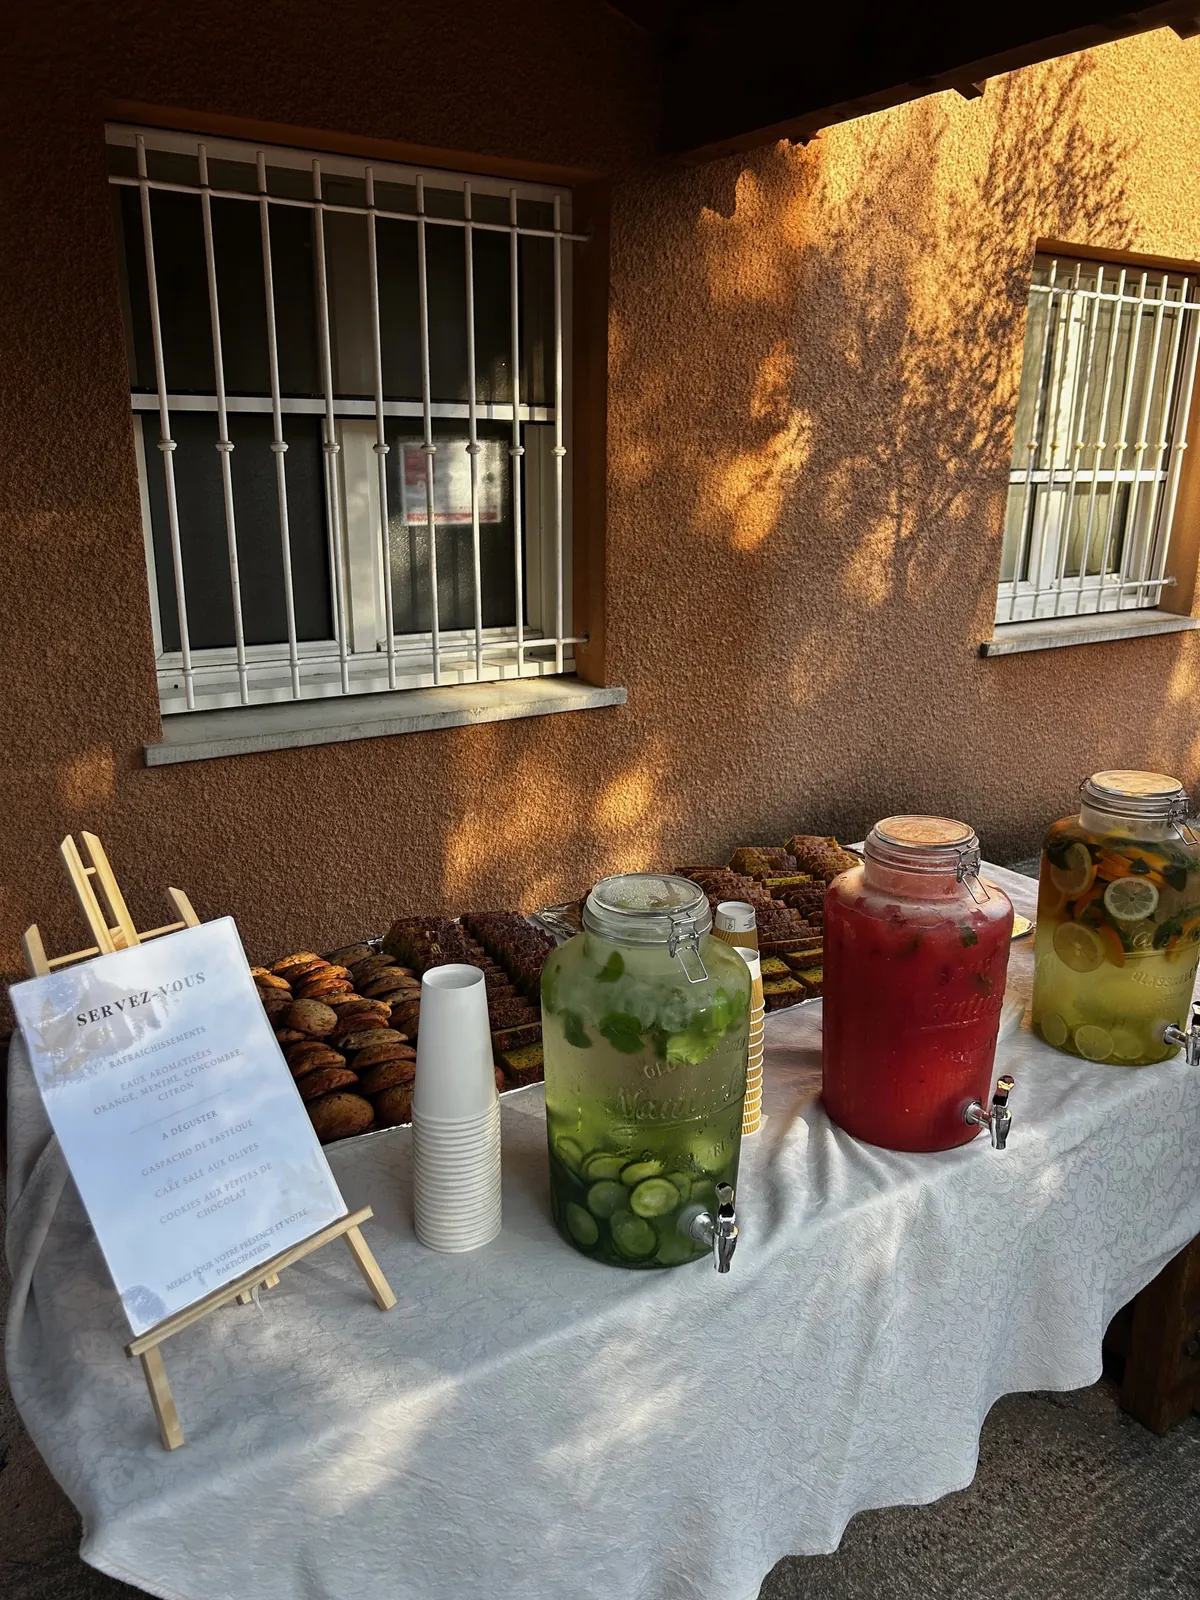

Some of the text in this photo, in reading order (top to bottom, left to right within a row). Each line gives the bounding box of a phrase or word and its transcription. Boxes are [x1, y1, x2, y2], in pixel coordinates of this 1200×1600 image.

[76, 971, 206, 1027] SERVEZ-VOUS
[109, 1025, 207, 1069] RAFRAICHISSEMENTS
[120, 1048, 213, 1091] EAUX AROMATISÉES
[93, 1092, 139, 1116] ORANGE,
[157, 1081, 195, 1102] CITRON
[170, 1109, 219, 1136] DÉGUSTER
[141, 1147, 193, 1177] GASPACHO
[194, 1140, 208, 1152] DE
[154, 1142, 260, 1198] CAKE SALÉ AUX OLIVES
[159, 1161, 273, 1224] COOKIES AUX PÉPITES DE
[196, 1188, 248, 1219] CHOCOLAT
[166, 1208, 308, 1291] MERCI POUR VOTRE PRÉSENCE ET VOTRE
[216, 1240, 272, 1276] PARTICIPATION
